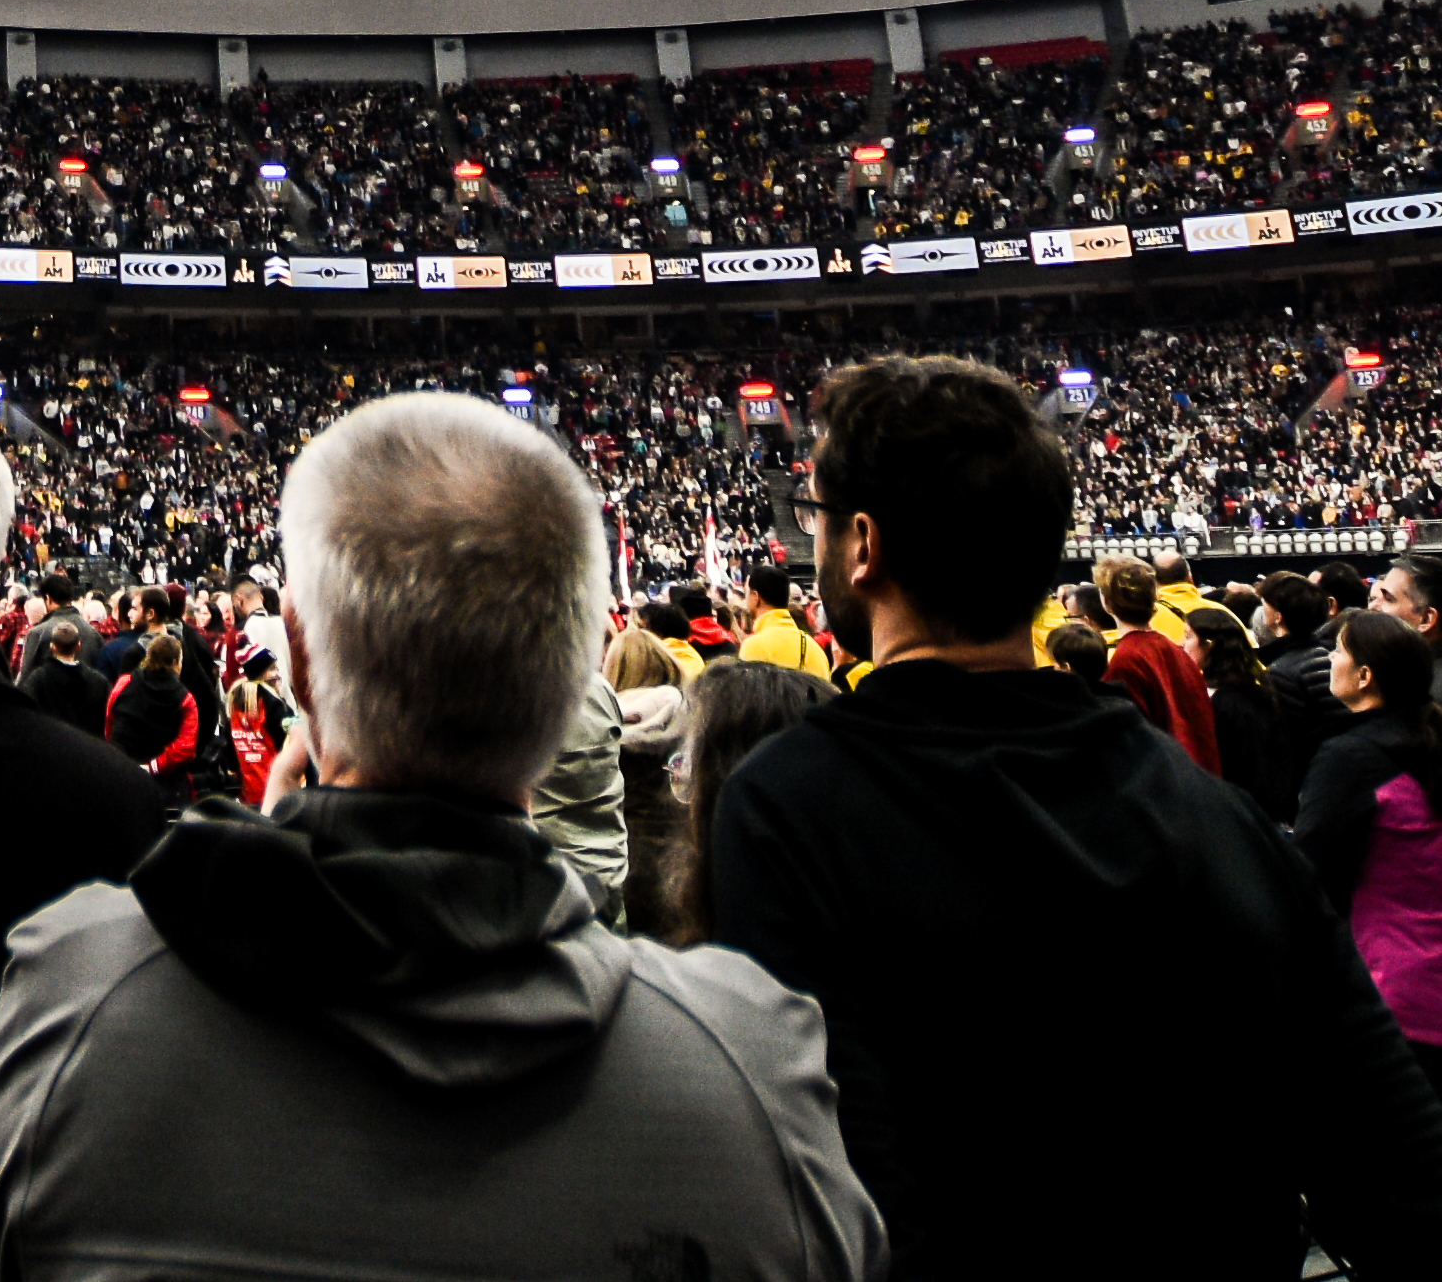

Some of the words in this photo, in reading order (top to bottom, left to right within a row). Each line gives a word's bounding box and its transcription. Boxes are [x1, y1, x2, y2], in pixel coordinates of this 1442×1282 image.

[1307, 120, 1327, 132] 452
[1075, 145, 1094, 157] 451
[1294, 209, 1343, 223] INVICTUS
[1264, 217, 1271, 228] I
[1299, 218, 1336, 230] GAMES
[1132, 225, 1179, 238] INVICTUS
[1258, 228, 1282, 240] AM
[980, 239, 1027, 251] INVICTUS
[1048, 236, 1054, 246] I
[1136, 235, 1174, 246] GAMES
[834, 248, 841, 261] I
[984, 247, 1021, 259] GAMES
[1042, 247, 1064, 259] AM
[51, 256, 56, 267] I
[76, 257, 117, 268] INVICTUS
[241, 258, 247, 270] I
[433, 262, 437, 272] I
[628, 260, 633, 270] I
[655, 258, 699, 270] INVICTUS
[827, 259, 852, 273] AM
[44, 267, 62, 277] AM
[78, 265, 110, 275] GAMES
[371, 262, 414, 273] INVICTUS
[508, 262, 552, 273] INVICTUS
[658, 266, 692, 276] GAMES
[233, 270, 255, 283] AM
[374, 270, 407, 280] GAMES
[426, 272, 445, 283] AM
[512, 270, 545, 280] GAMES
[621, 270, 641, 281] AM
[1069, 390, 1089, 401] 251
[750, 402, 771, 413] 249
